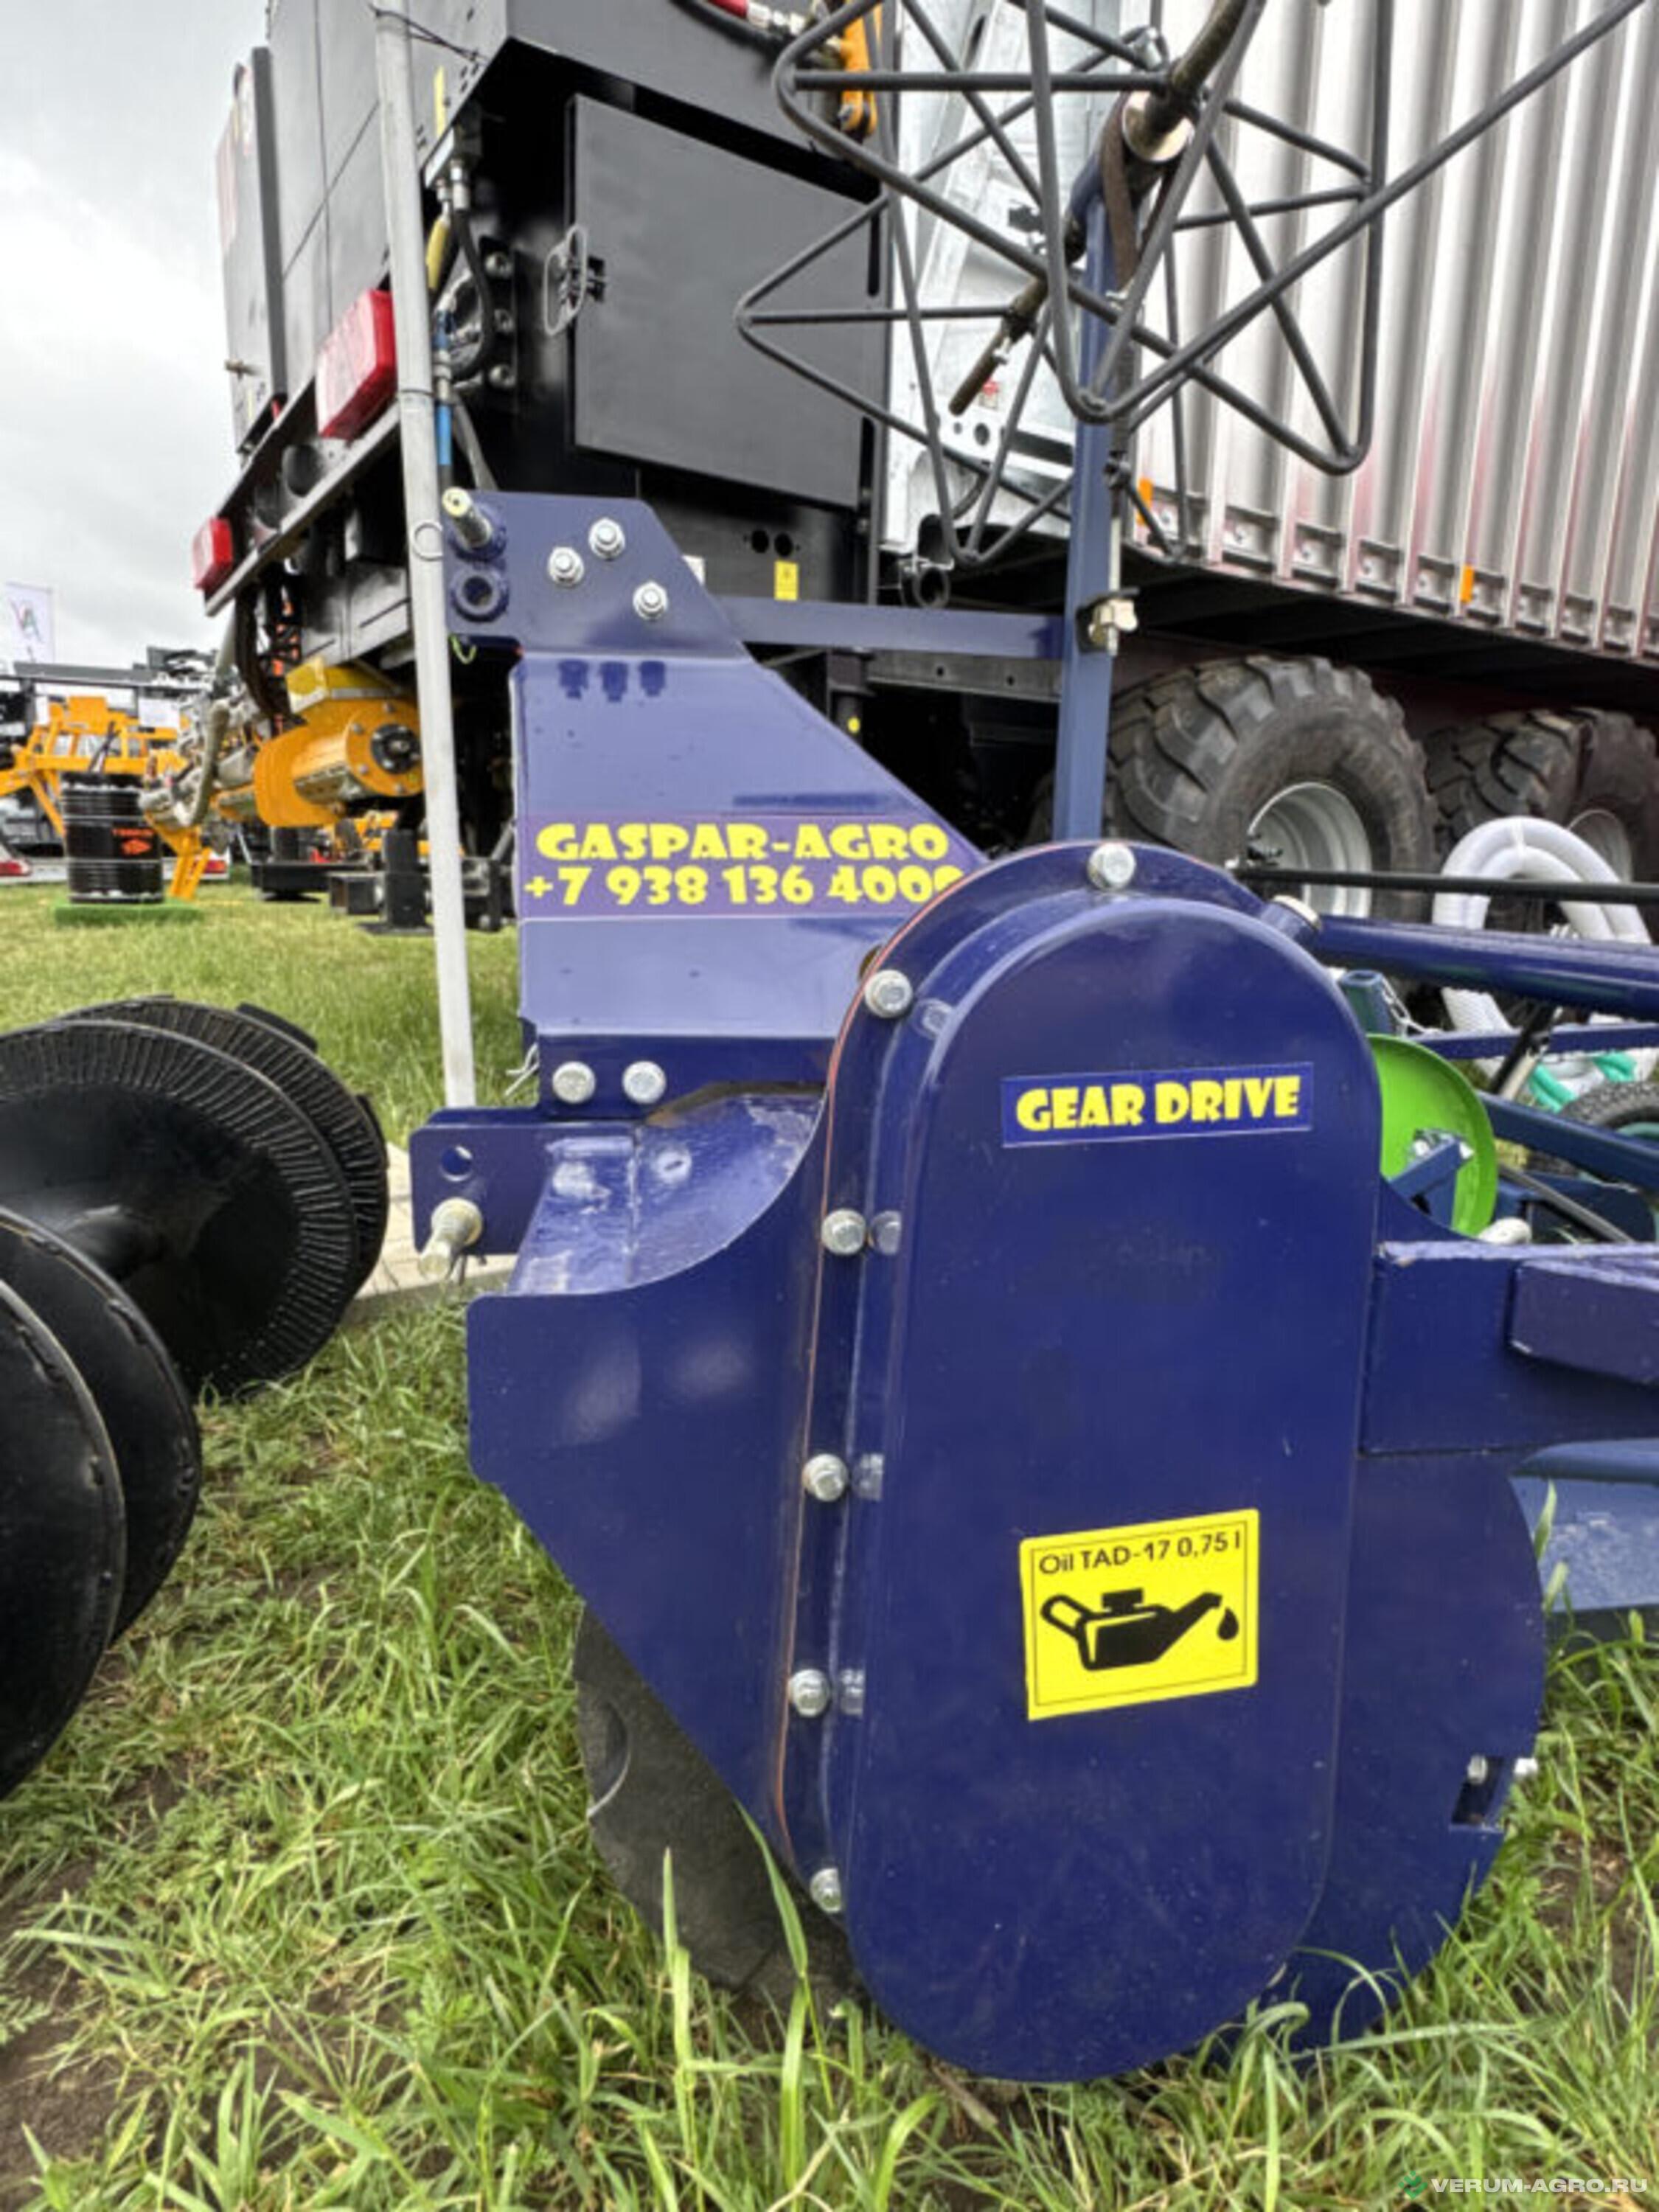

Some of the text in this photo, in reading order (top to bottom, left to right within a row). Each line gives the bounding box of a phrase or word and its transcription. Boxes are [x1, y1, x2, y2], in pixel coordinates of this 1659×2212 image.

[536, 823, 949, 860] GASPAR-AGRO
[525, 866, 592, 905] +7
[605, 866, 708, 905] 938
[722, 866, 814, 903] 136
[1016, 1075, 1300, 1131] GEAR DRIVE
[1039, 1554, 1074, 1575] Oil
[1080, 1540, 1170, 1570] TAD-17
[1178, 1532, 1228, 1558] 0,75
